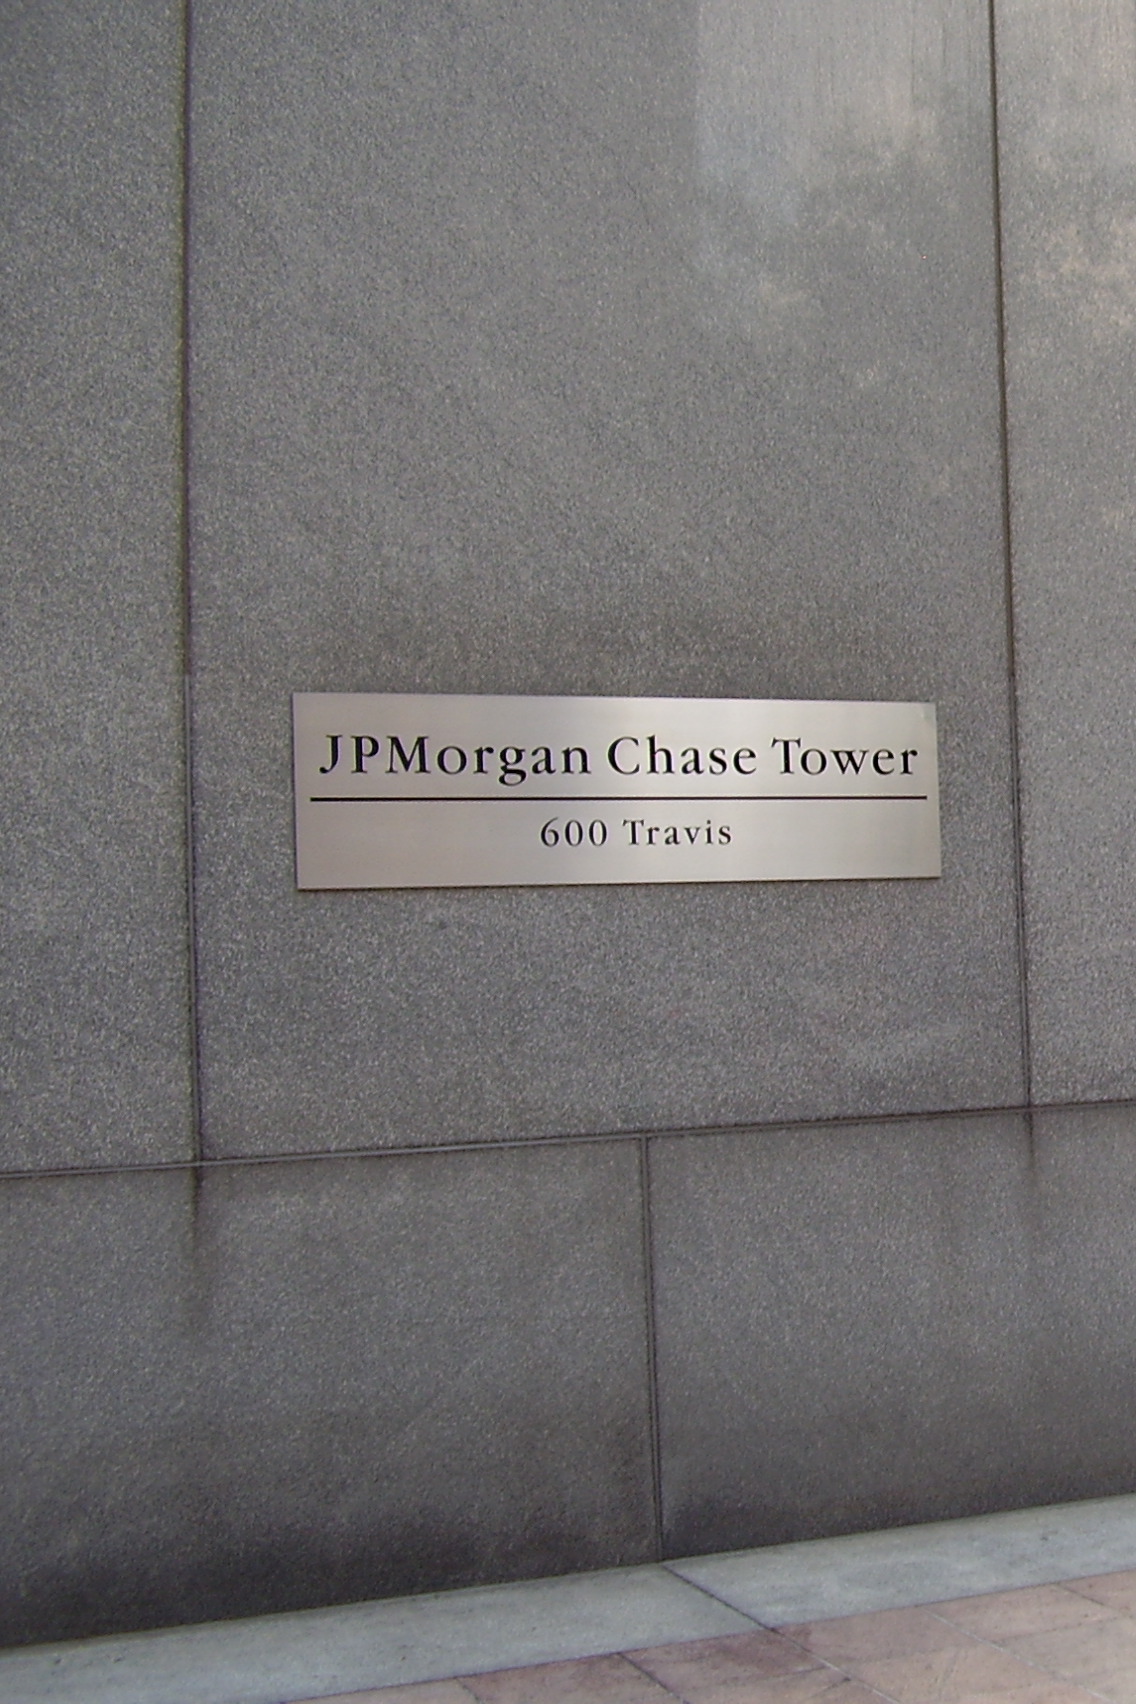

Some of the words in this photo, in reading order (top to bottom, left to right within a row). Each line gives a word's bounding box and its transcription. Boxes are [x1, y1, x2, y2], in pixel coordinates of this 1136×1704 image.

[319, 734, 592, 786] JPMorgan
[607, 734, 757, 776] Chase
[770, 736, 919, 776] Tower
[540, 817, 608, 848] 600
[622, 818, 732, 846] Travis
